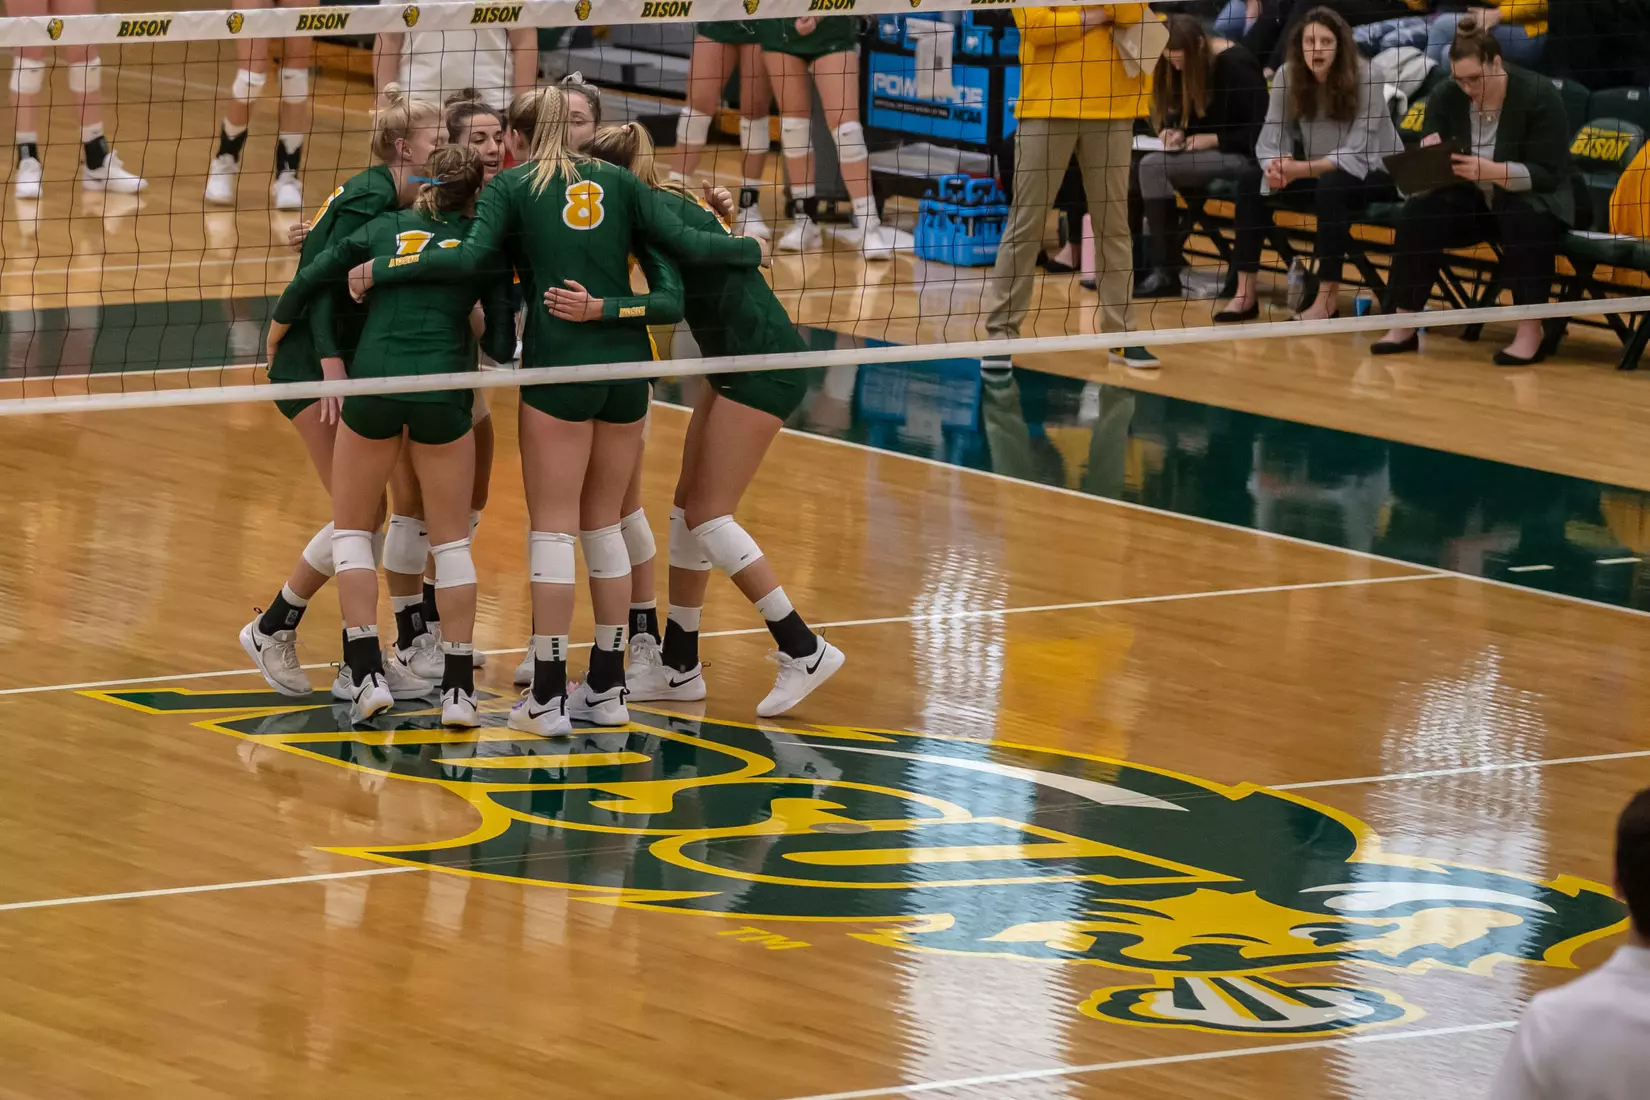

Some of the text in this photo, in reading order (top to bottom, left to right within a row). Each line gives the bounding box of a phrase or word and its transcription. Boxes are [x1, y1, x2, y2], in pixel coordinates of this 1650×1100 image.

[470, 6, 523, 24] BISON
[641, 1, 692, 18] BISON
[117, 19, 172, 37] BISON
[295, 13, 351, 31] BISON
[873, 72, 983, 109] POWDE
[1569, 133, 1631, 161] BISON
[562, 180, 605, 230] 8
[716, 926, 812, 950] TM
